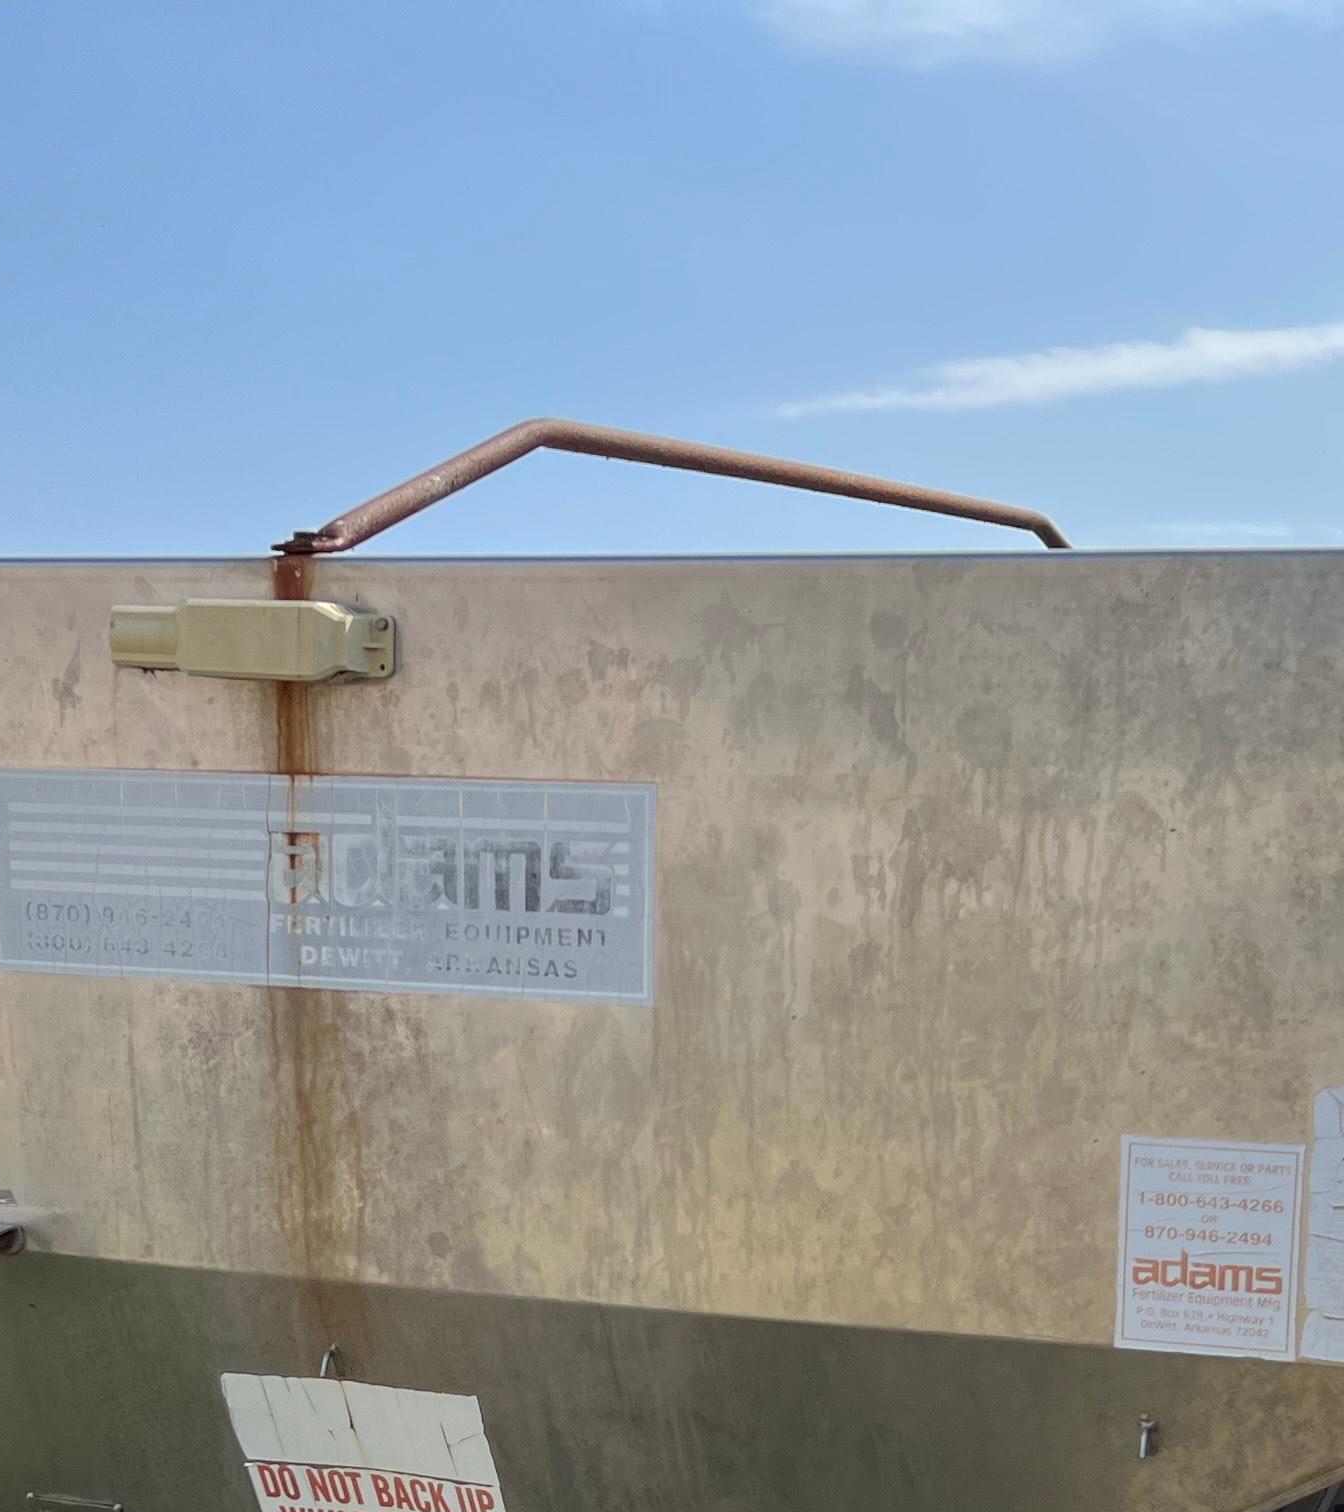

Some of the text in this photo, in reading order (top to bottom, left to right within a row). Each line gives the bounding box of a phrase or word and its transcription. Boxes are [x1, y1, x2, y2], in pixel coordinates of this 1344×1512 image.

[25, 901, 91, 925] (870)
[1134, 1157, 1155, 1168] FOR
[1194, 1160, 1237, 1172] SERVICE
[1239, 1162, 1255, 1173] OR
[1258, 1164, 1291, 1175] PARTS
[1168, 1171, 1193, 1182] CALL
[1197, 1173, 1220, 1184] TOLL
[1138, 1191, 1285, 1214] 1-800-643-4266
[1201, 1215, 1218, 1224] OR
[1144, 1225, 1273, 1246] 870-946-2494
[1132, 1248, 1283, 1295] adams
[1132, 1287, 1184, 1301] Fertilizer
[1187, 1292, 1253, 1308] Equipment
[1160, 1307, 1180, 1318] Box
[258, 1464, 301, 1500] DO
[306, 1467, 365, 1505] NOT
